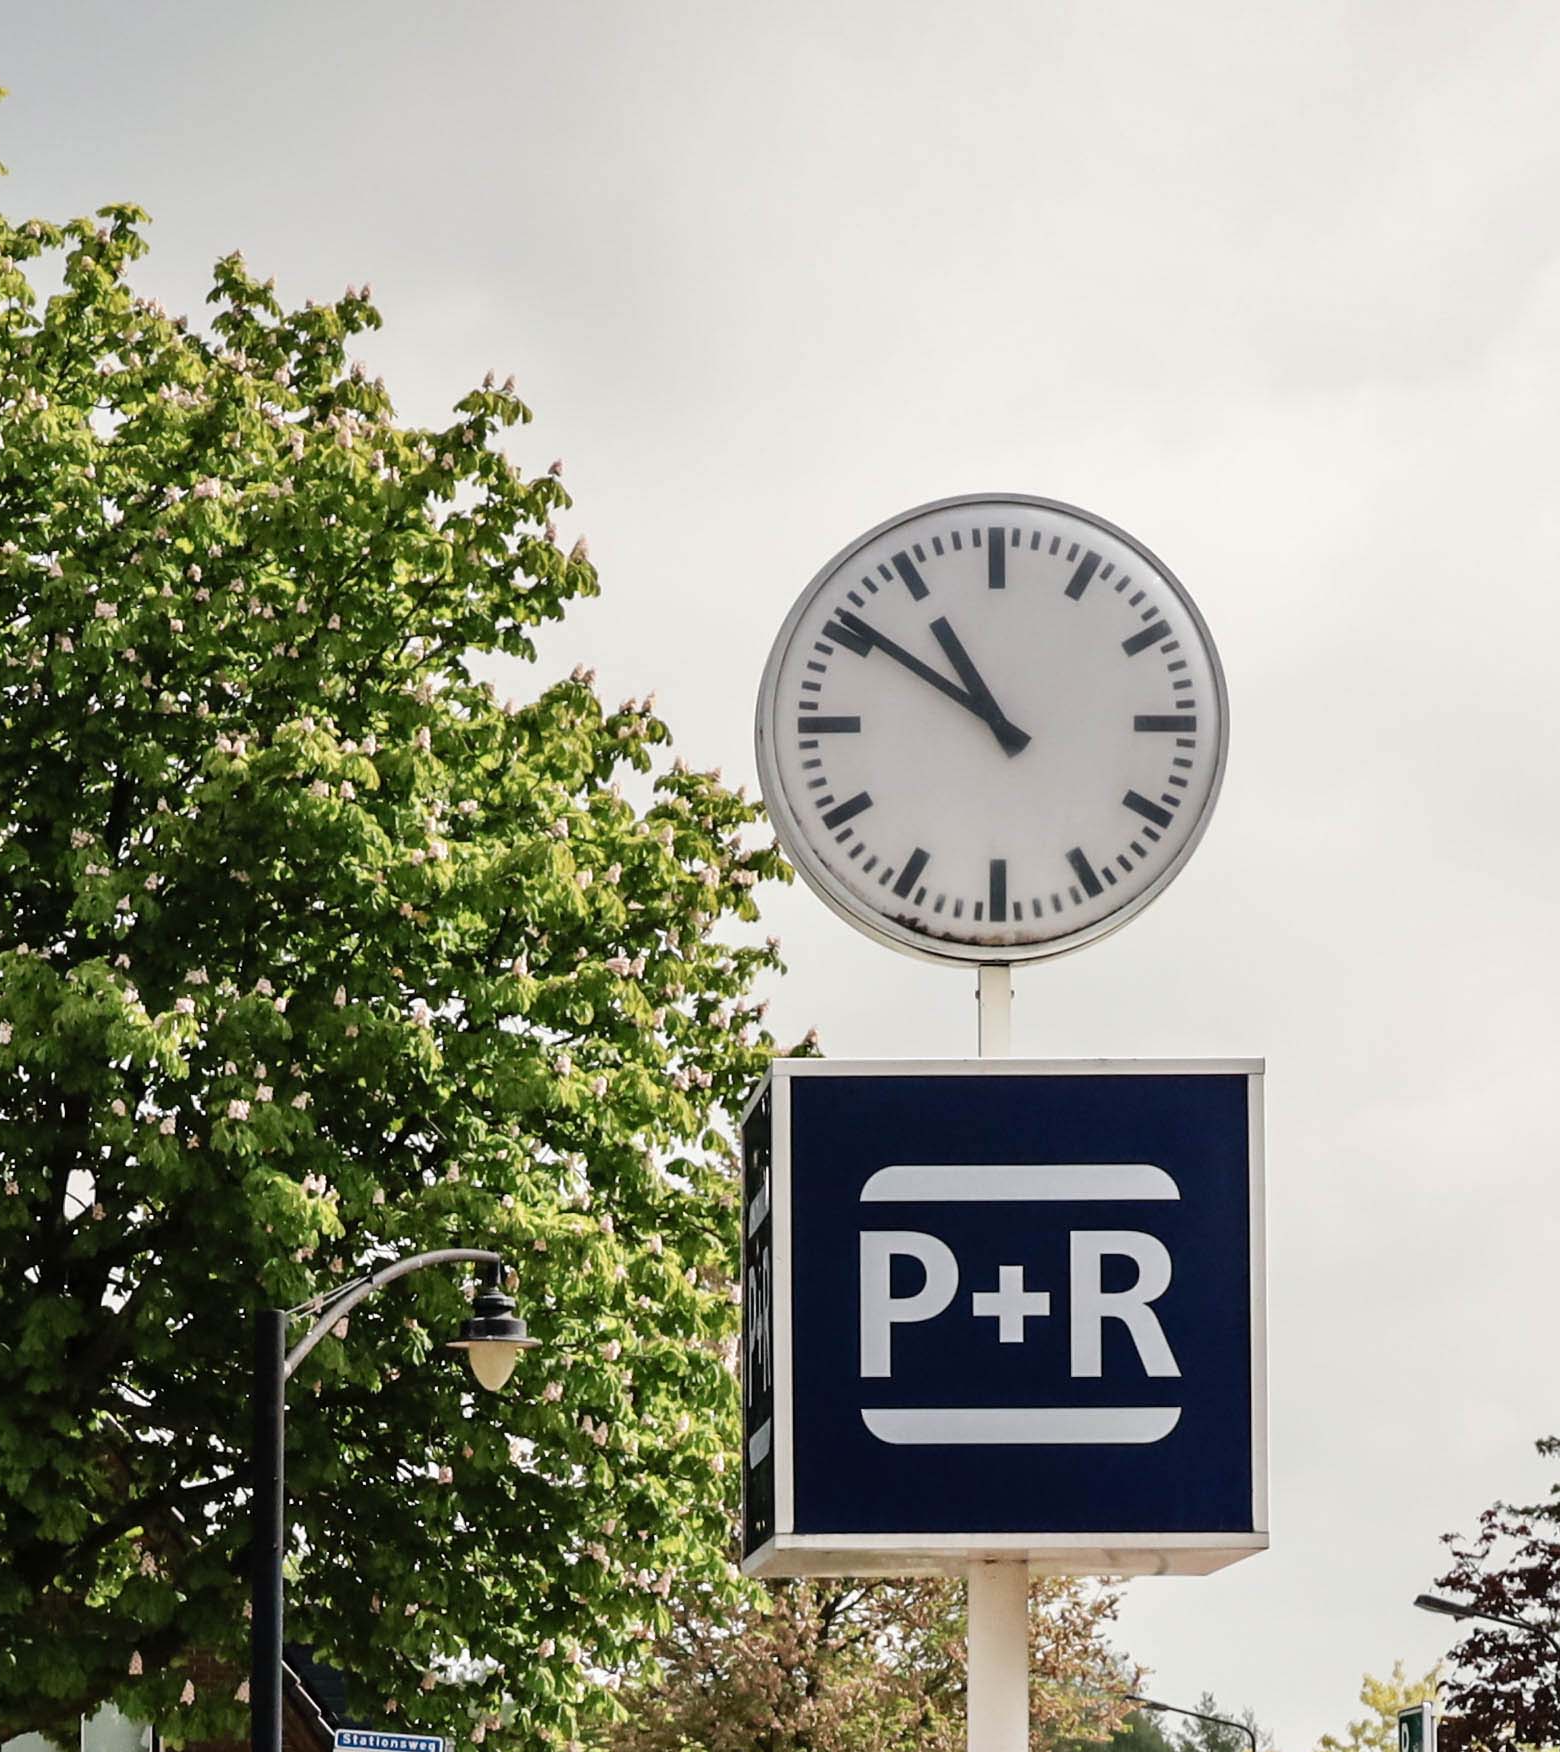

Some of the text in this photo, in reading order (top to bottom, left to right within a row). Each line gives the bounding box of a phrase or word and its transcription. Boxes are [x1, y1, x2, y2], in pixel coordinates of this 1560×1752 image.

[747, 1243, 771, 1408] P+R
[860, 1230, 1182, 1377] P+R
[342, 1733, 436, 1752] Stationsweg
